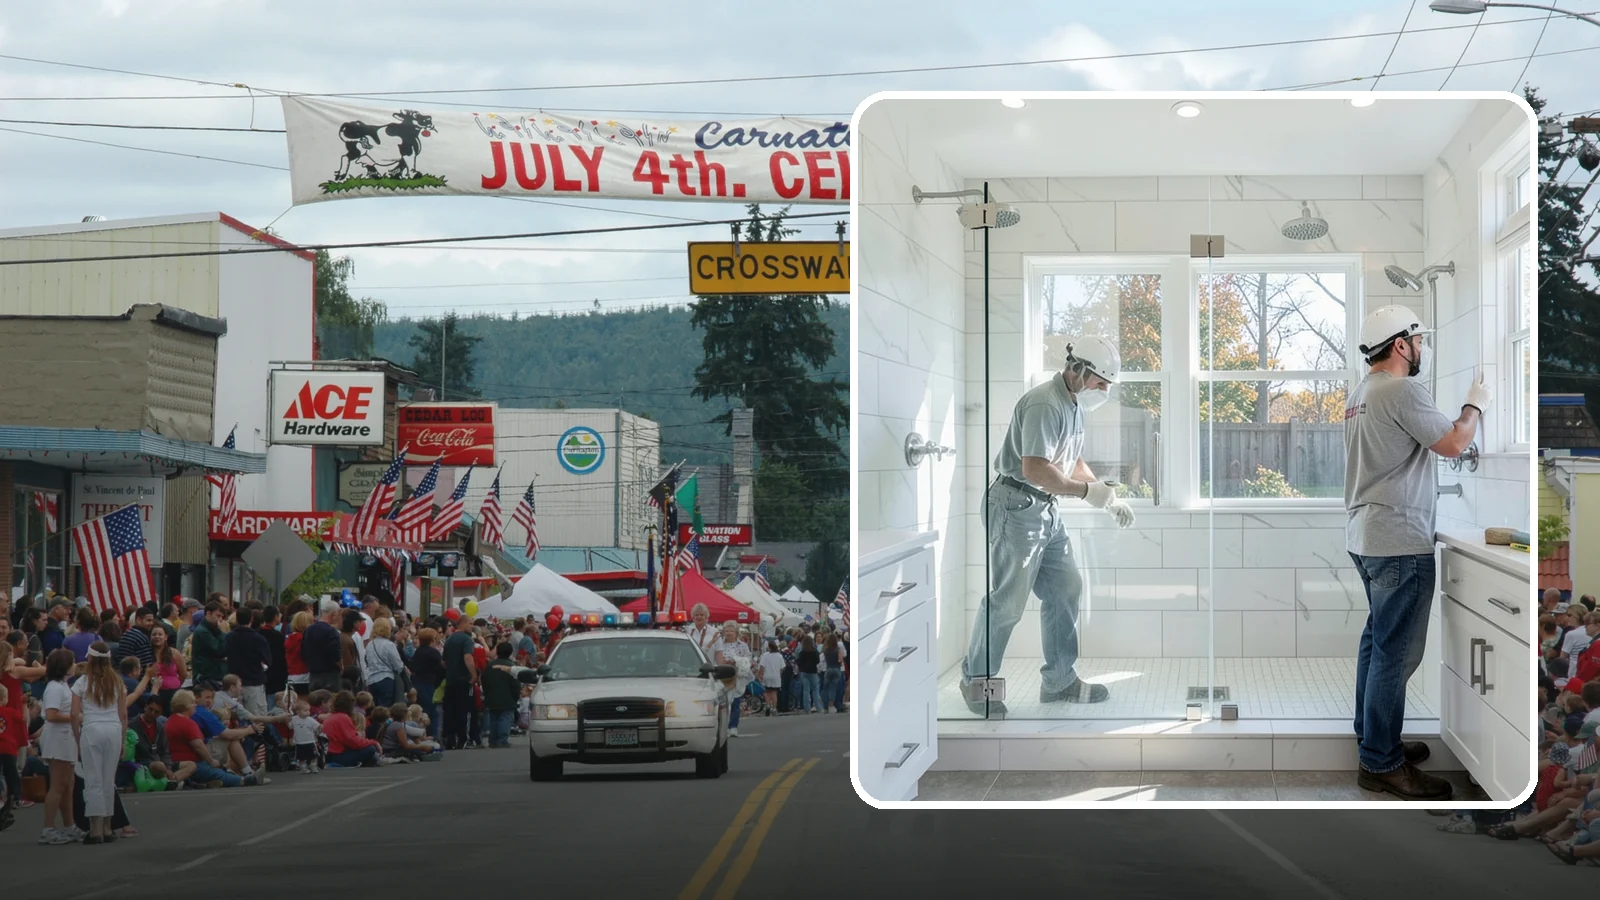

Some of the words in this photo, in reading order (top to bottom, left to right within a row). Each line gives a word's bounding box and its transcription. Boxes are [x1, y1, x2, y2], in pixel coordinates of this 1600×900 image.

[481, 140, 605, 192] JULY
[632, 150, 746, 198] 4th.
[697, 254, 850, 280] CROSSWA
[283, 380, 373, 420] ACE
[405, 410, 452, 422] CEDAR
[283, 421, 370, 436] Hardware
[416, 428, 477, 447] Coca-Cola
[83, 486, 93, 494] St.
[96, 485, 124, 494] Vincent
[126, 486, 136, 494] de
[137, 485, 155, 495] Paul
[688, 526, 742, 535] CRNATION
[699, 535, 730, 543] GLASS
